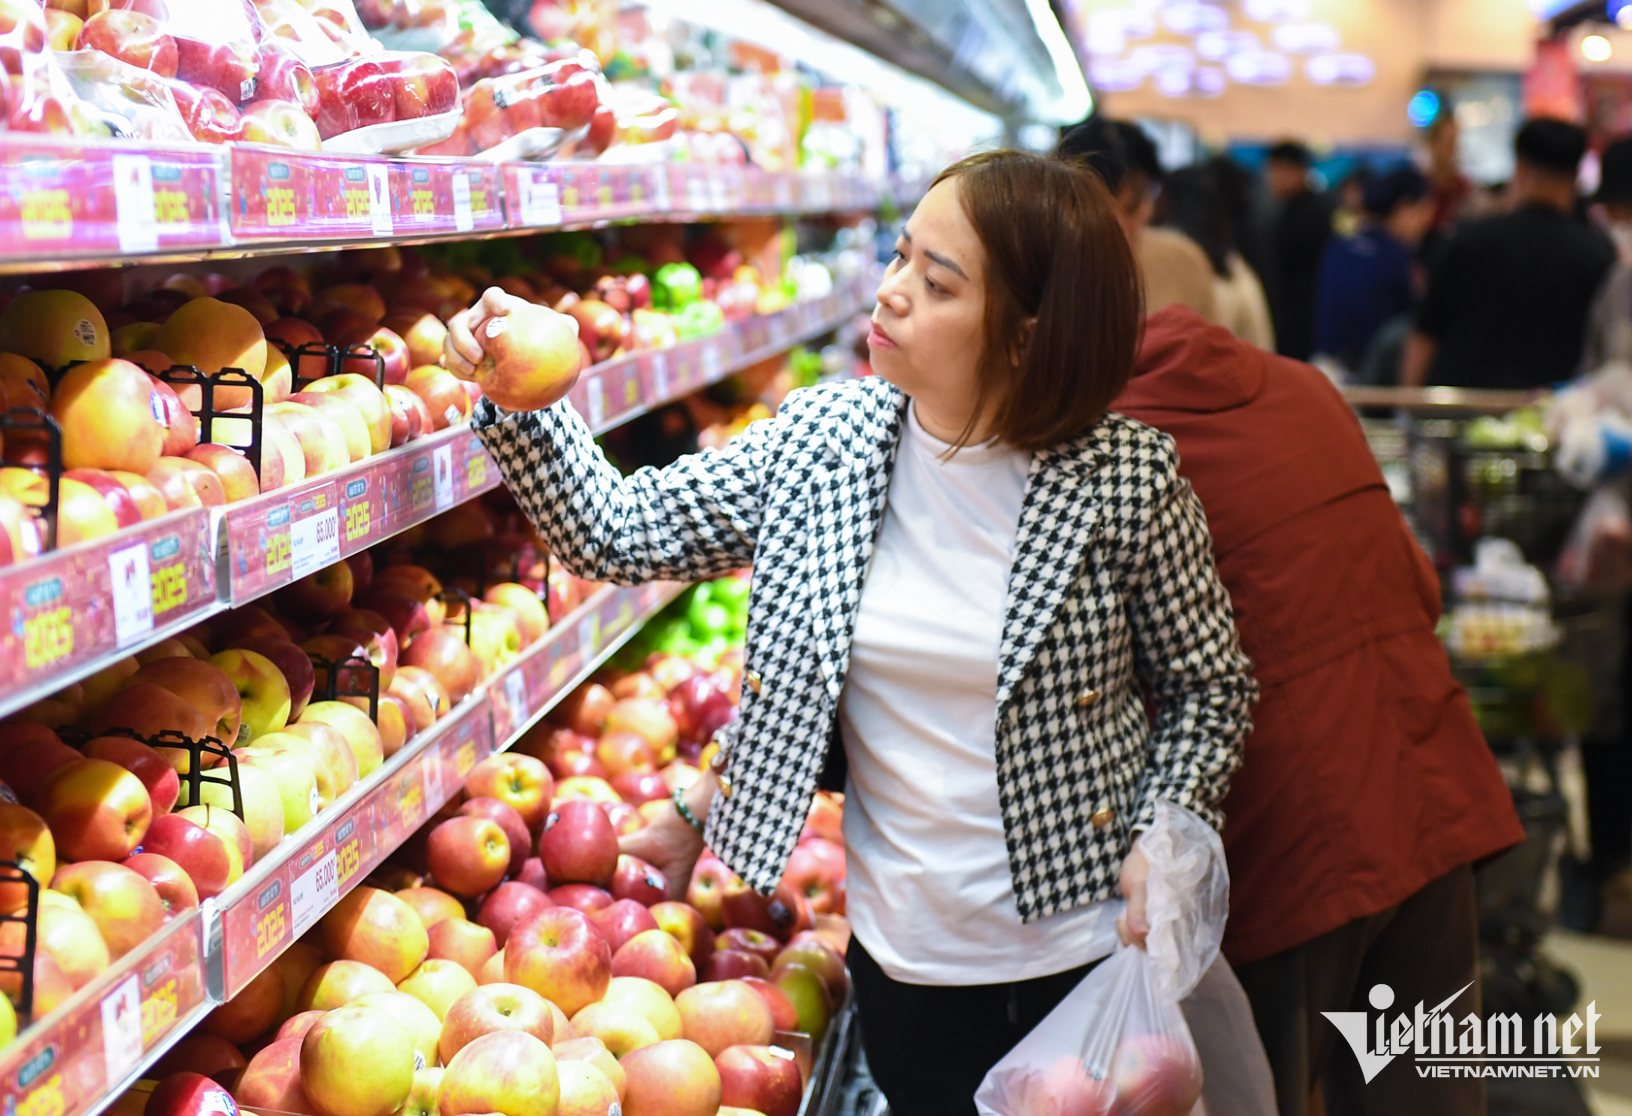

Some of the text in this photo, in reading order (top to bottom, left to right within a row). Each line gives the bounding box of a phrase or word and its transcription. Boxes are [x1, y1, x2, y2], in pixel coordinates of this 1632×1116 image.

[266, 188, 296, 226] 2025
[345, 501, 370, 541] 2025
[336, 838, 359, 887] 2025
[256, 902, 285, 959] 2025
